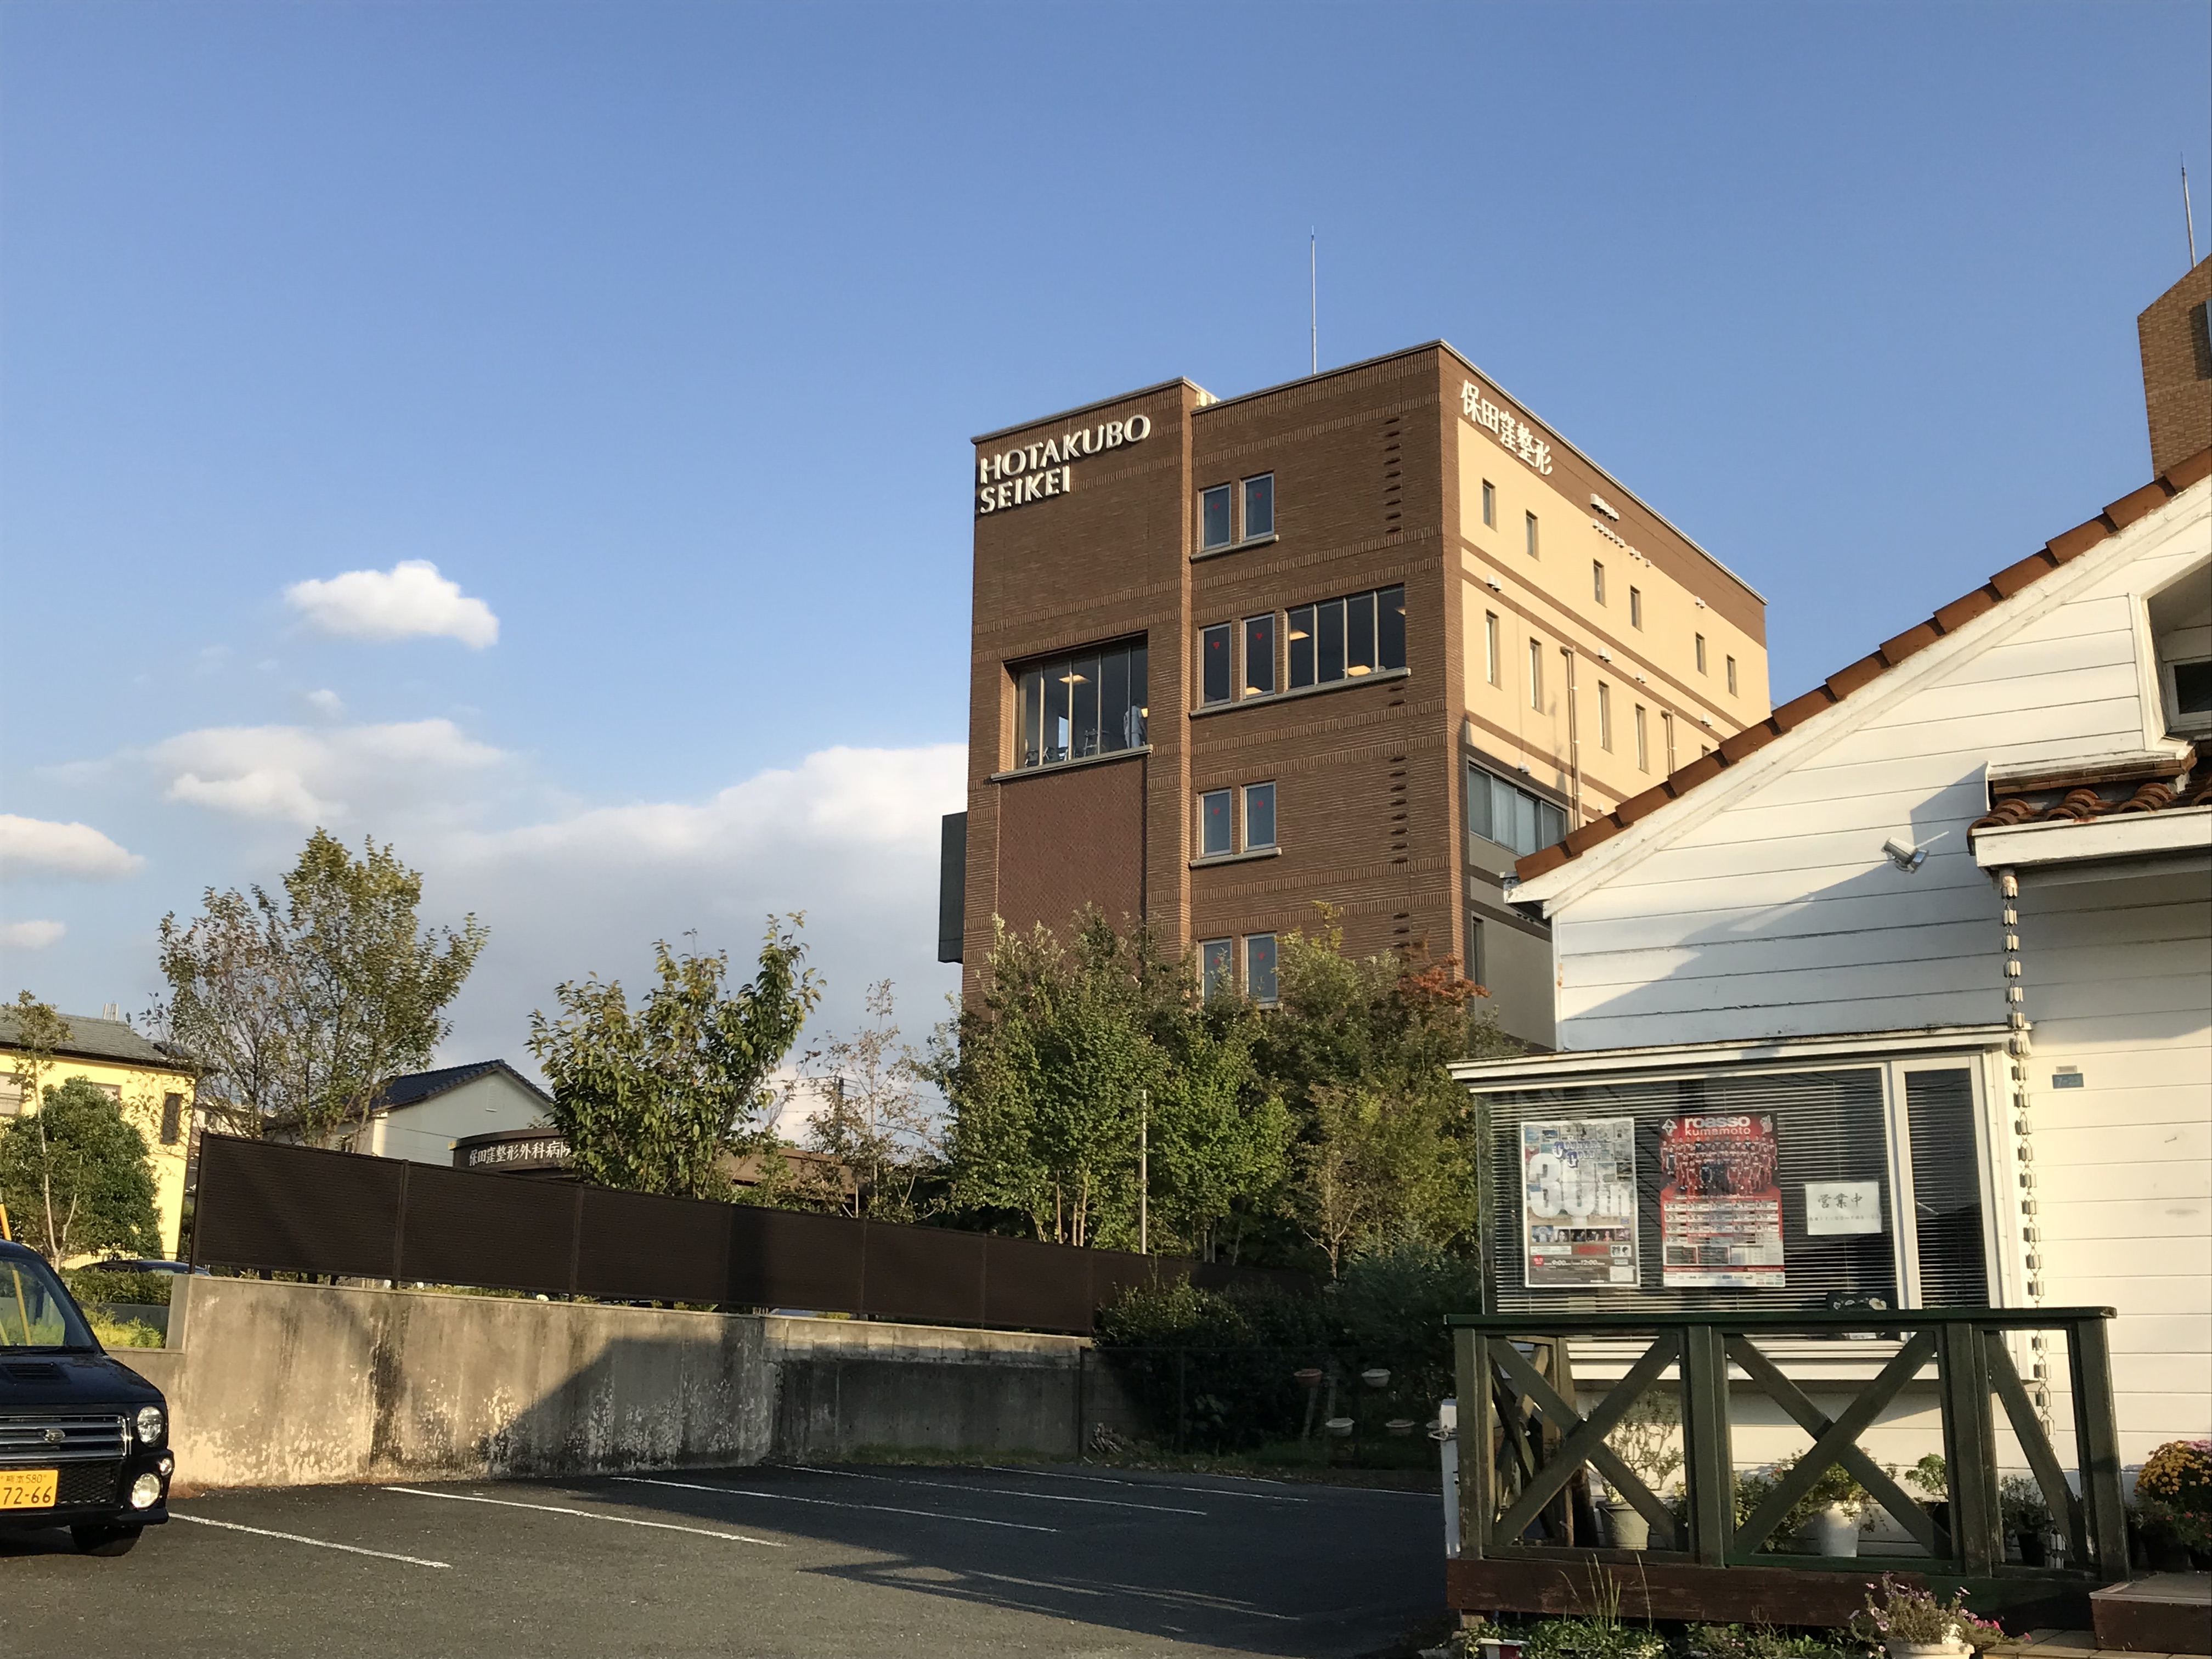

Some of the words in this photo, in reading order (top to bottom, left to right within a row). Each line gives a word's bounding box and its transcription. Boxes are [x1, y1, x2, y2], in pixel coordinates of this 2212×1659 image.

[1460, 379, 1553, 476] 保田窪整形
[980, 414, 1150, 484] HOTAKUBO
[980, 465, 1070, 514] SEIKEI
[1685, 1116, 1751, 1128] roasso
[1685, 1127, 1751, 1136] kumamoto
[1818, 1192, 1863, 1209] 営業中
[3, 1486, 52, 1505] 72-66
